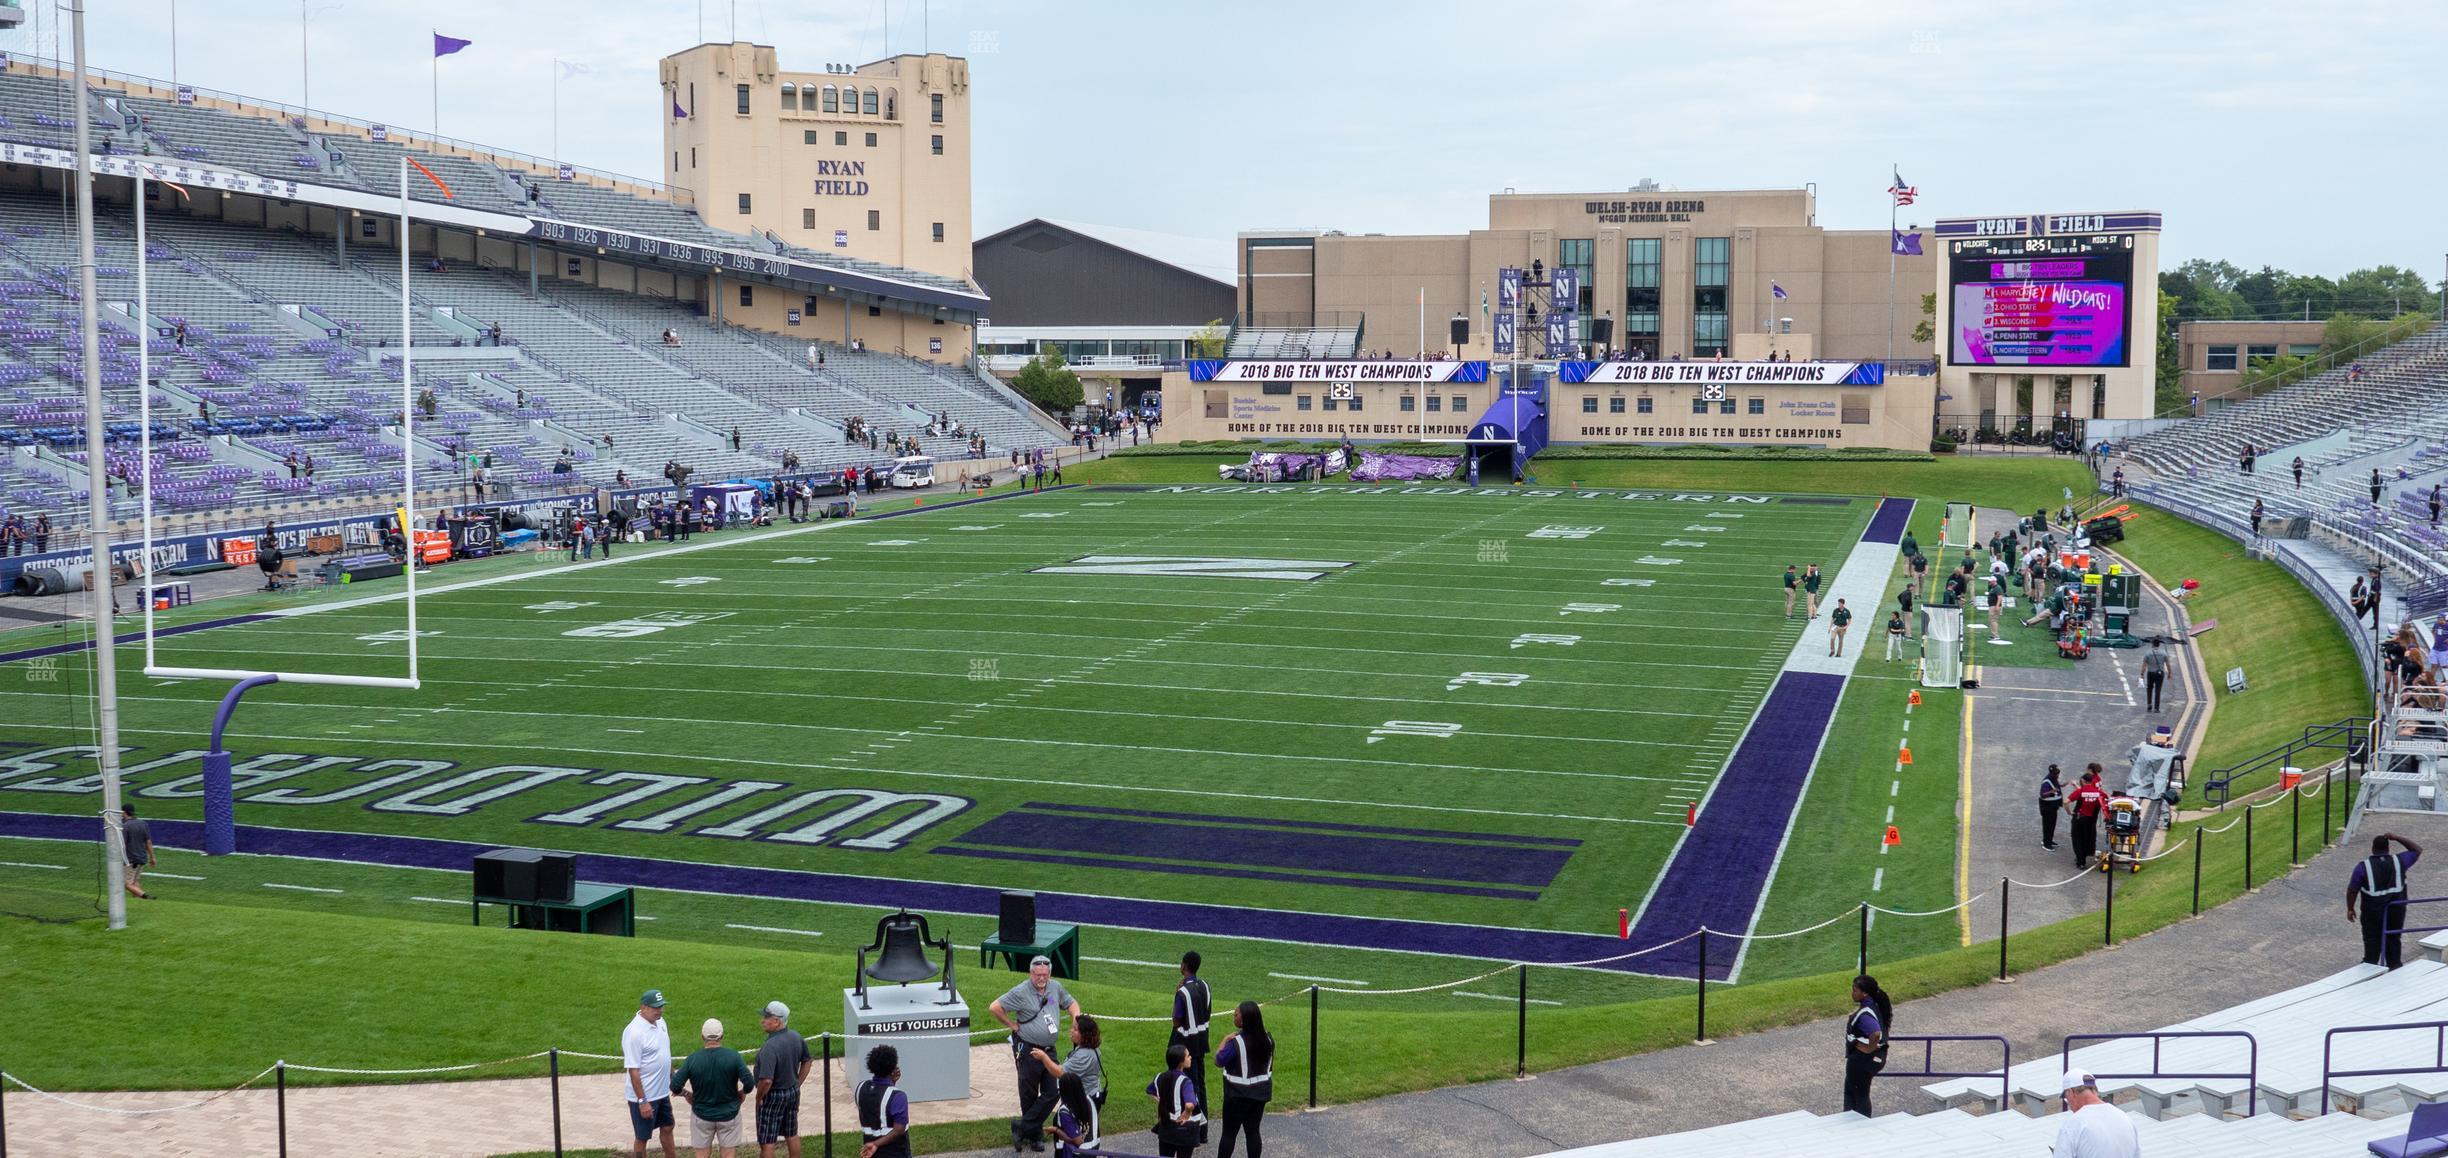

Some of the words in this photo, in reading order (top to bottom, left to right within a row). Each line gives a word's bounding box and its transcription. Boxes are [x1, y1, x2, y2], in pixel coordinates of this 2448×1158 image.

[373, 130, 385, 139] 233
[560, 169, 572, 178] 234
[817, 160, 865, 176] RYAN
[815, 180, 869, 196] FIELD
[1586, 201, 1661, 214] WELSH-RYAN
[1666, 200, 1704, 212] ARENA
[1629, 214, 1668, 222] MEMORIAL
[1671, 214, 1691, 222] HALL
[1976, 218, 2017, 235] RYAN
[2058, 216, 2105, 232] FIELD
[541, 222, 565, 239] 1903
[574, 228, 598, 244] 1926
[607, 233, 630, 249] 1930
[639, 239, 660, 255] 1931
[669, 244, 692, 260] 1936
[701, 249, 724, 265] 1995
[732, 254, 755, 270] 1996
[764, 261, 789, 276] 2000
[1955, 242, 1961, 253] 0
[1963, 240, 1989, 248] WILDCATS
[2092, 236, 2107, 244] MICH
[2125, 237, 2132, 249] 0
[1504, 279, 1517, 298] N
[1556, 279, 1569, 298] N
[2052, 283, 2111, 310] WILDCATS!
[788, 312, 800, 322] 135
[1498, 324, 1512, 343] N
[1550, 324, 1564, 343] N
[929, 341, 941, 350] 136
[1999, 346, 2047, 354] NORTHWESTERN
[1241, 364, 1269, 378] 2018
[1274, 364, 1295, 378] BIG
[1299, 364, 1321, 378] TEN
[1325, 364, 1357, 379] WEST
[1360, 364, 1433, 379] CHAMPIONS
[1615, 366, 1647, 380] 2018
[1651, 366, 1674, 380] BIG
[1679, 366, 1702, 380] TEN
[1708, 366, 1742, 380] WEST
[1747, 366, 1825, 381] CHAMPIONS
[1334, 383, 1351, 397] 25
[1705, 385, 1723, 399] 25
[1779, 401, 1796, 409] John
[1228, 423, 1255, 432] HOME
[1259, 423, 1271, 432] OF
[1276, 424, 1295, 432] THE
[1300, 424, 1323, 432] 2018
[1328, 424, 1345, 433] BIG
[1350, 424, 1369, 433] TEN
[1374, 425, 1403, 433] WEST
[1483, 426, 1494, 440] N
[1581, 427, 1610, 435] HOME
[1615, 427, 1628, 435] OF
[1633, 427, 1654, 436] THE
[1659, 427, 1684, 436] 2018
[1689, 428, 1708, 436] BIG
[1713, 428, 1734, 437] TEN
[1740, 428, 1771, 437] WEST
[1776, 429, 1841, 438] CHAMPIONS
[1471, 461, 1477, 469] N
[207, 537, 217, 560] N
[1911, 695, 1919, 703] 20
[1370, 720, 1463, 738] 10
[1889, 831, 1897, 840] G
[655, 992, 662, 1001] S
[869, 1022, 903, 1033] TRUST
[907, 1018, 961, 1031] YOURSELF
